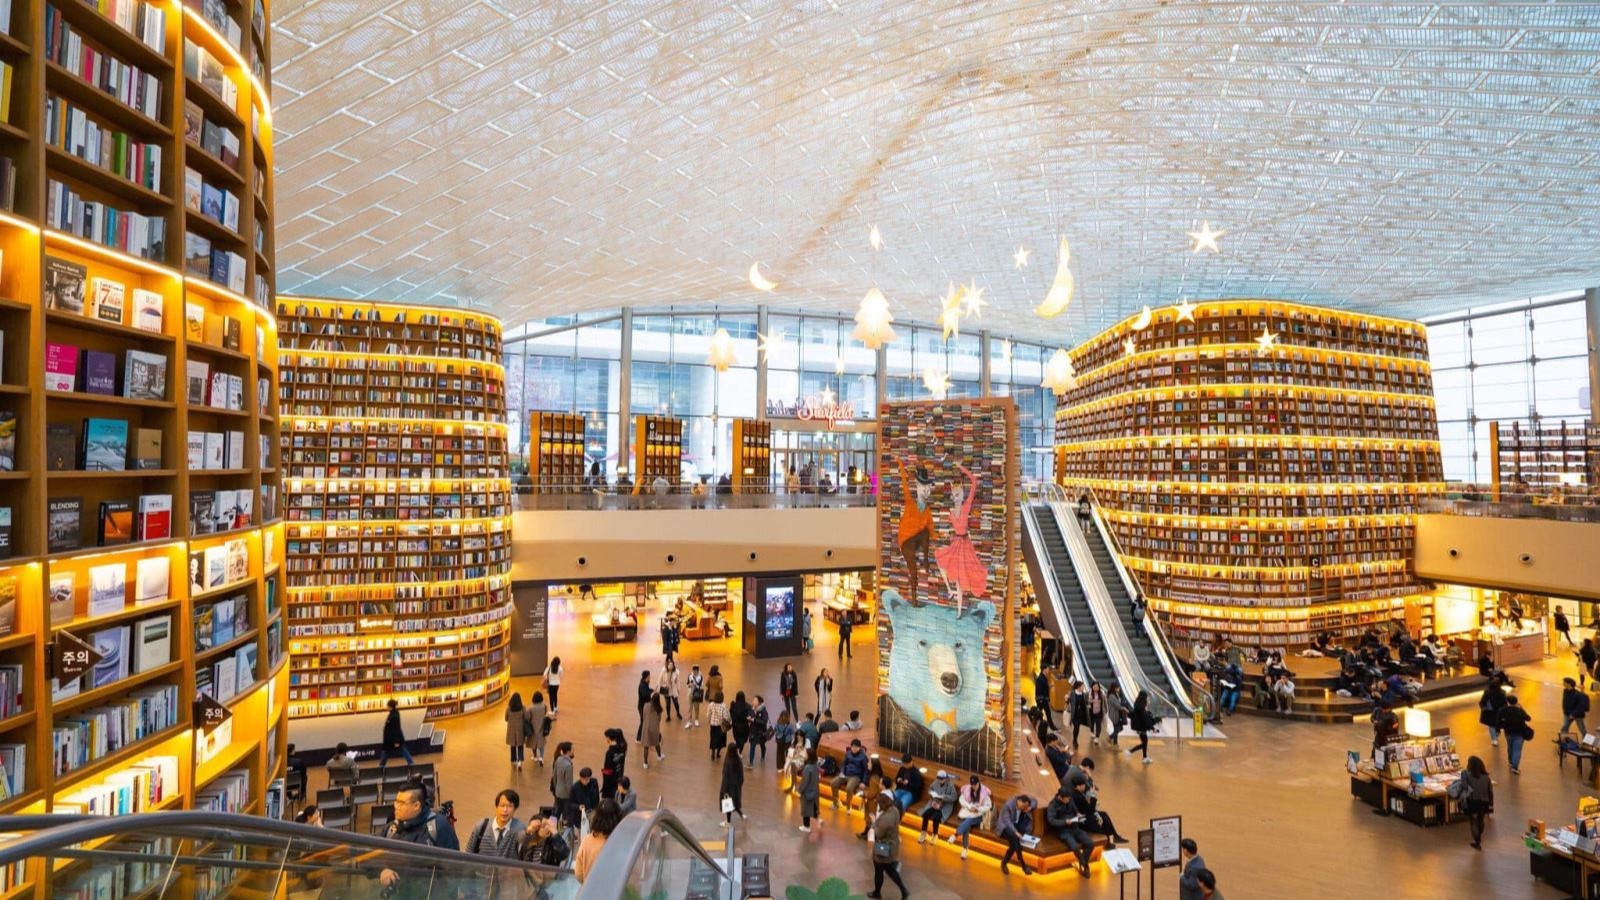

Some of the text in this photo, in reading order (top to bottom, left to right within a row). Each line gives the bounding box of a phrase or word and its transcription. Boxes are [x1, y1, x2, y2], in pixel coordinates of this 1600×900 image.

[798, 396, 855, 430] Starfield
[50, 501, 79, 510] BLENDING
[62, 650, 89, 665] 주의
[205, 708, 223, 719] 주의
